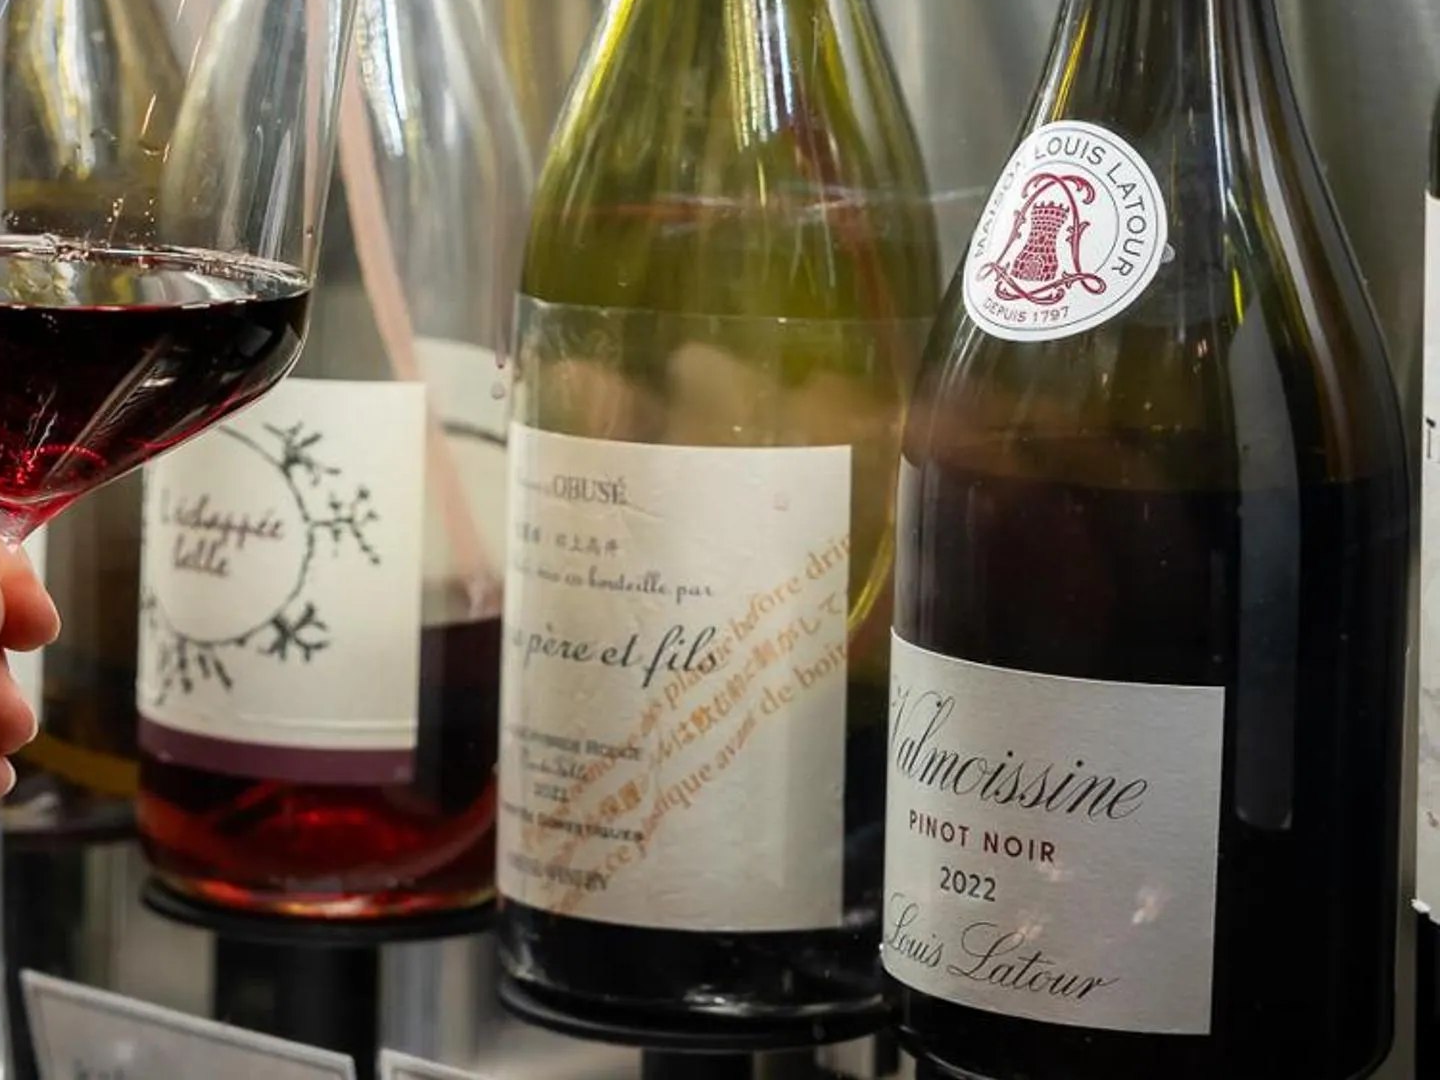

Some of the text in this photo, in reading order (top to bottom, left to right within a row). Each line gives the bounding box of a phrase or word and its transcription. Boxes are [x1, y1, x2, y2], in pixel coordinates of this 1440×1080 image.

[1034, 136, 1108, 167] LOUIS
[1105, 161, 1148, 278] LATOUR
[982, 297, 1070, 323] DEPUIS 1797
[600, 633, 645, 667] et
[759, 684, 796, 716] de
[909, 809, 1057, 863] PINOT NOIR
[940, 865, 997, 903] 2022
[885, 891, 1119, 1000] Louis Latour
